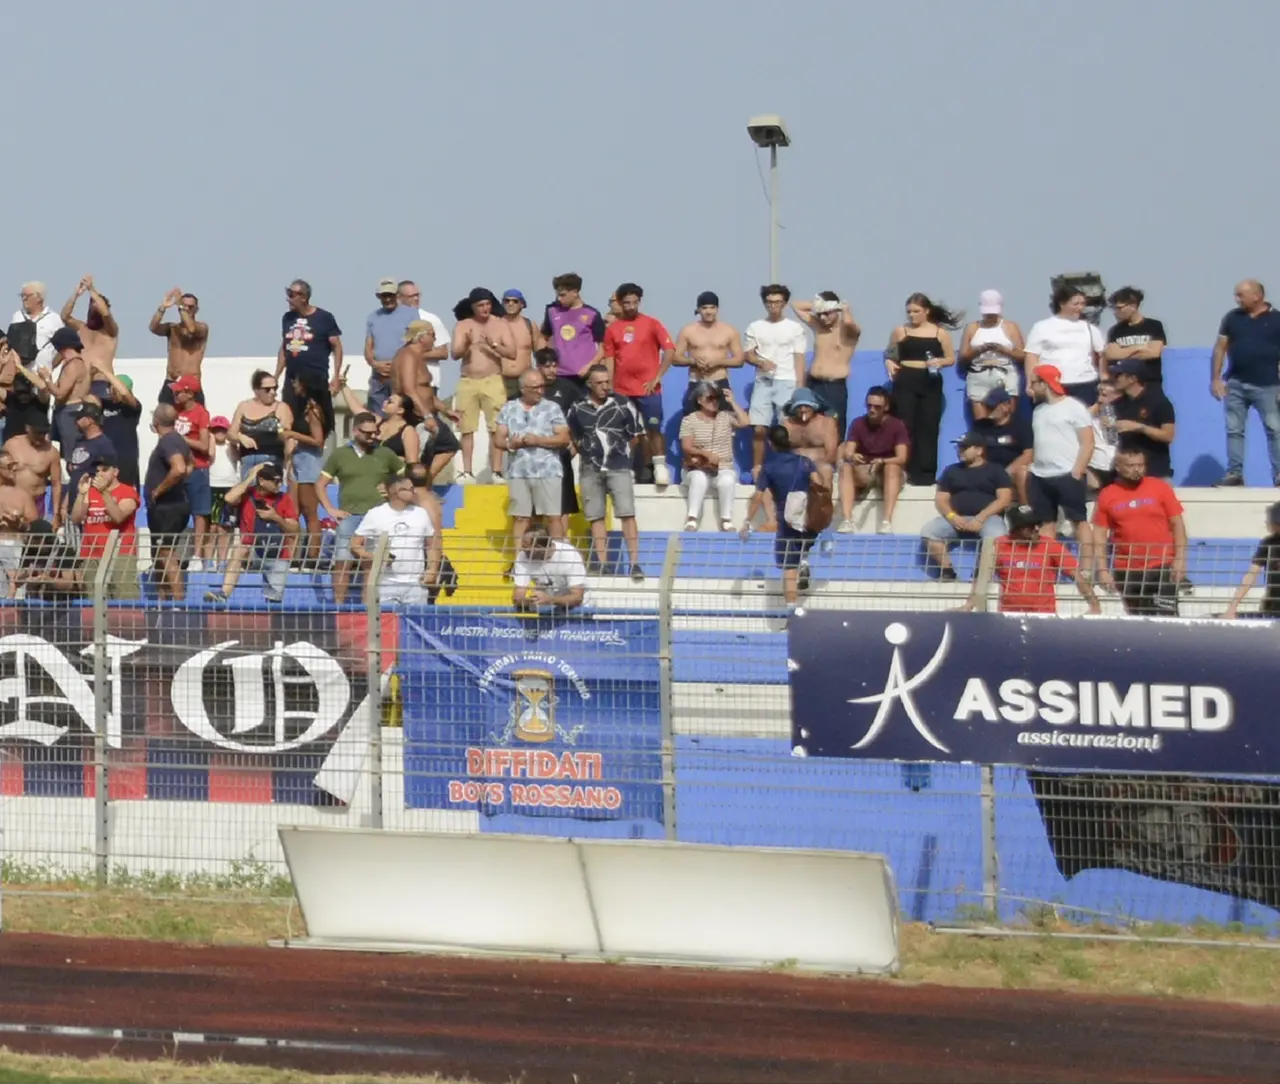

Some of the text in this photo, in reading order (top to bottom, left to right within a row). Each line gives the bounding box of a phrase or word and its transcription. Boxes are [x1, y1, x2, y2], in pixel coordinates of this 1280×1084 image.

[953, 677, 1234, 731] ASSIMED
[1016, 729, 1161, 753] assicurazioni
[466, 748, 602, 780] DIFFIDATI
[449, 781, 622, 809] BOYS ROSSANO
